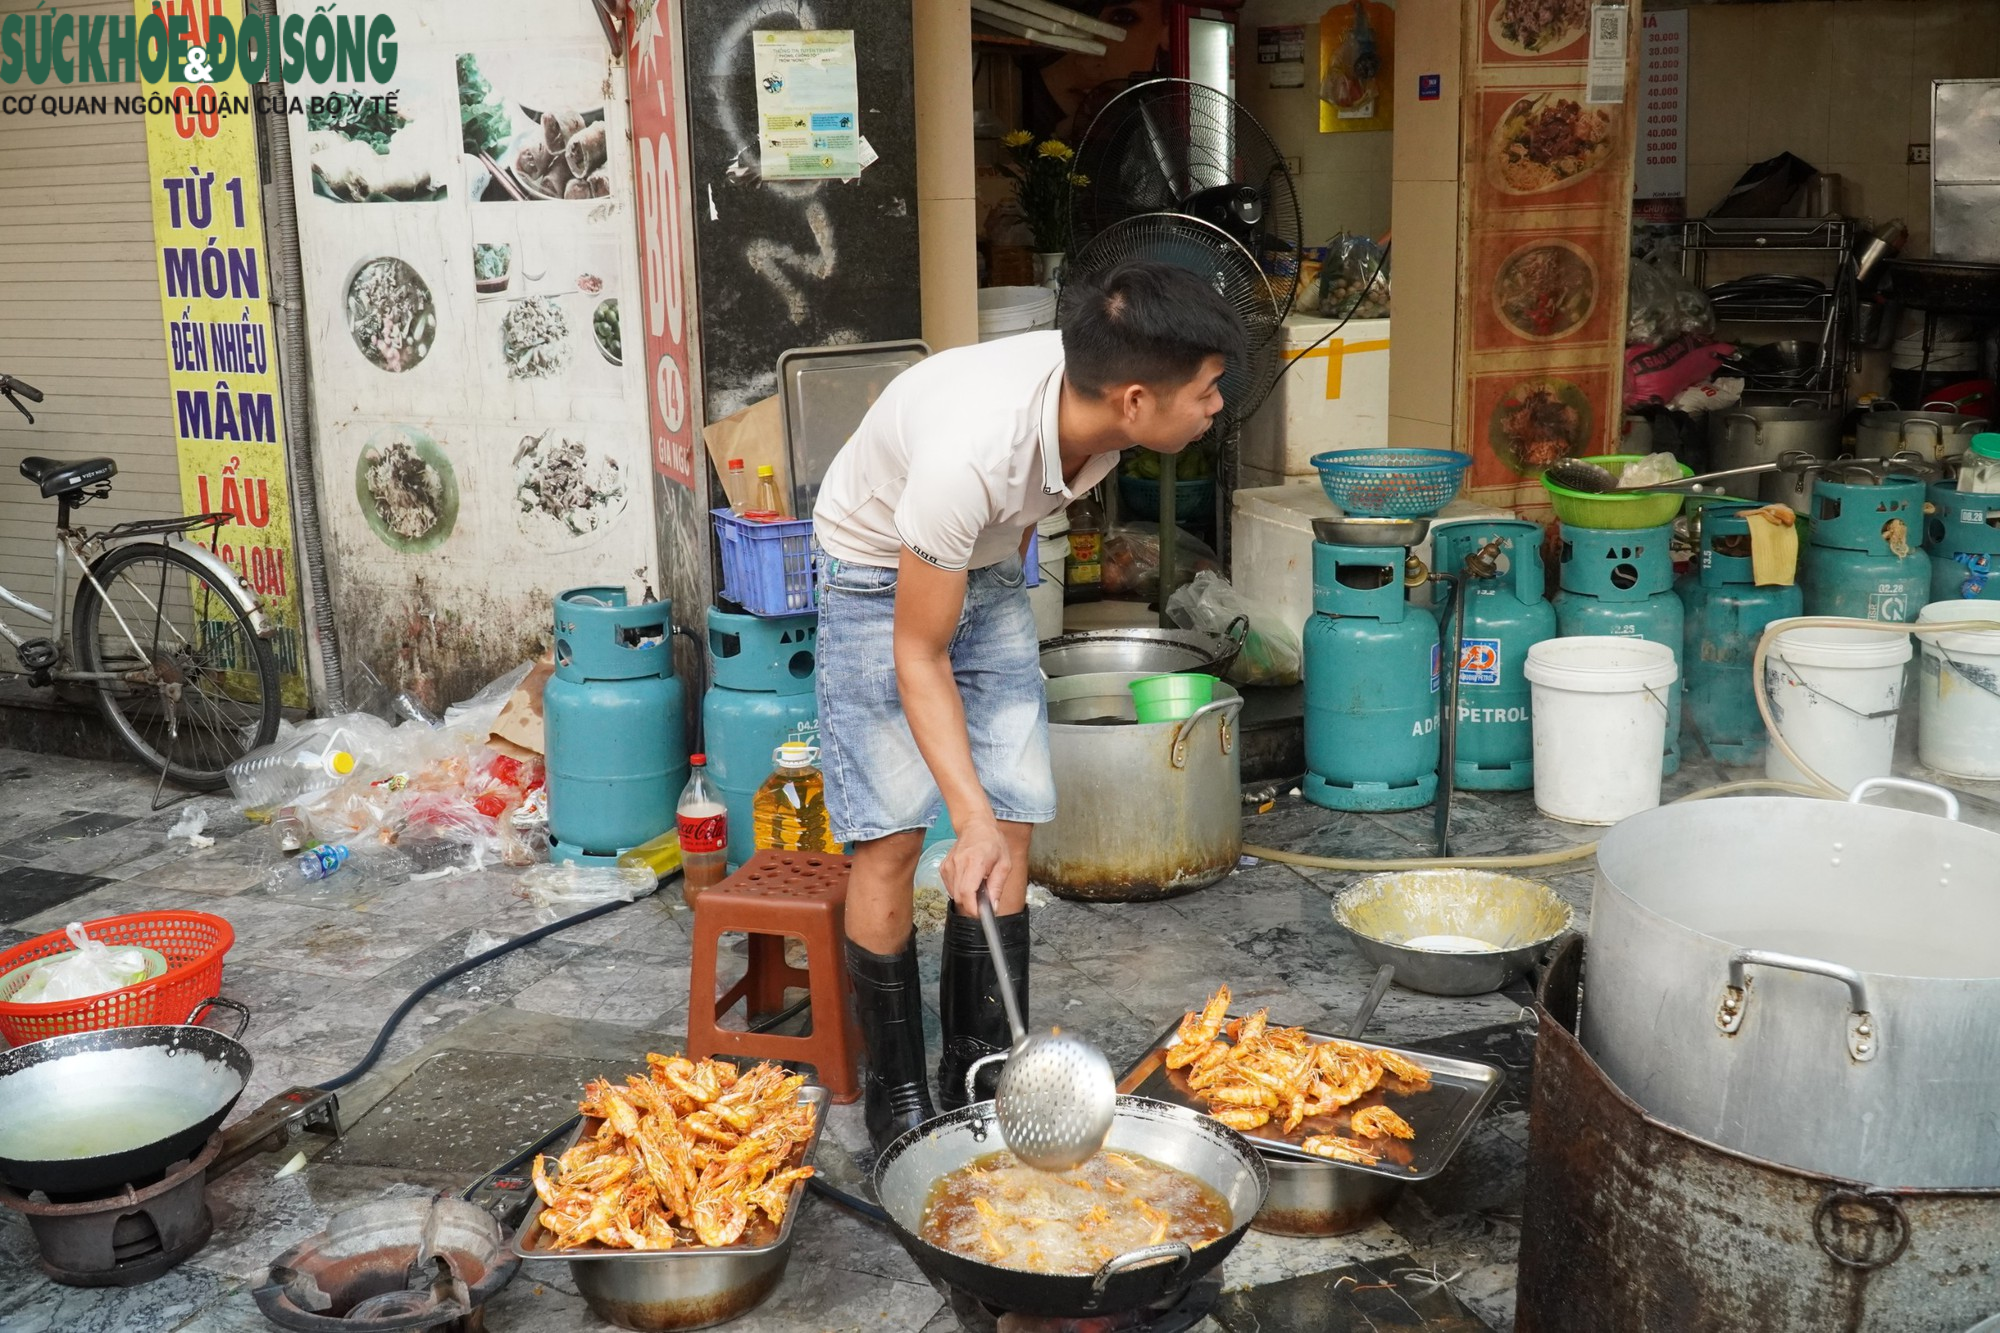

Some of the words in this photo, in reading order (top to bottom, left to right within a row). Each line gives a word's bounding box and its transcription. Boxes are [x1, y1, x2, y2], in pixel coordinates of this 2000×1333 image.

[1649, 32, 1679, 42] 30.000
[1648, 46, 1679, 56] 30.000
[1648, 60, 1678, 69] 40.000
[1648, 73, 1678, 83] 40.000
[1648, 87, 1678, 97] 40.000
[1647, 101, 1678, 110] 40.000
[1647, 114, 1677, 124] 40.000
[1647, 128, 1677, 138] 40.000
[1646, 142, 1677, 152] 50.000
[1646, 155, 1676, 165] 50.000
[163, 166, 214, 229] TỪ
[225, 177, 244, 229] 1
[163, 236, 260, 299] MÓN
[169, 305, 209, 372] ĐẾN
[210, 306, 268, 375] NHIỀU
[662, 366, 679, 422] 14
[176, 380, 276, 444] MÂM
[657, 436, 673, 468] GIA
[197, 456, 270, 528] LẨU
[1606, 547, 1644, 560] ADP
[1878, 583, 1904, 594] 02.28
[797, 719, 820, 732] 04.2
